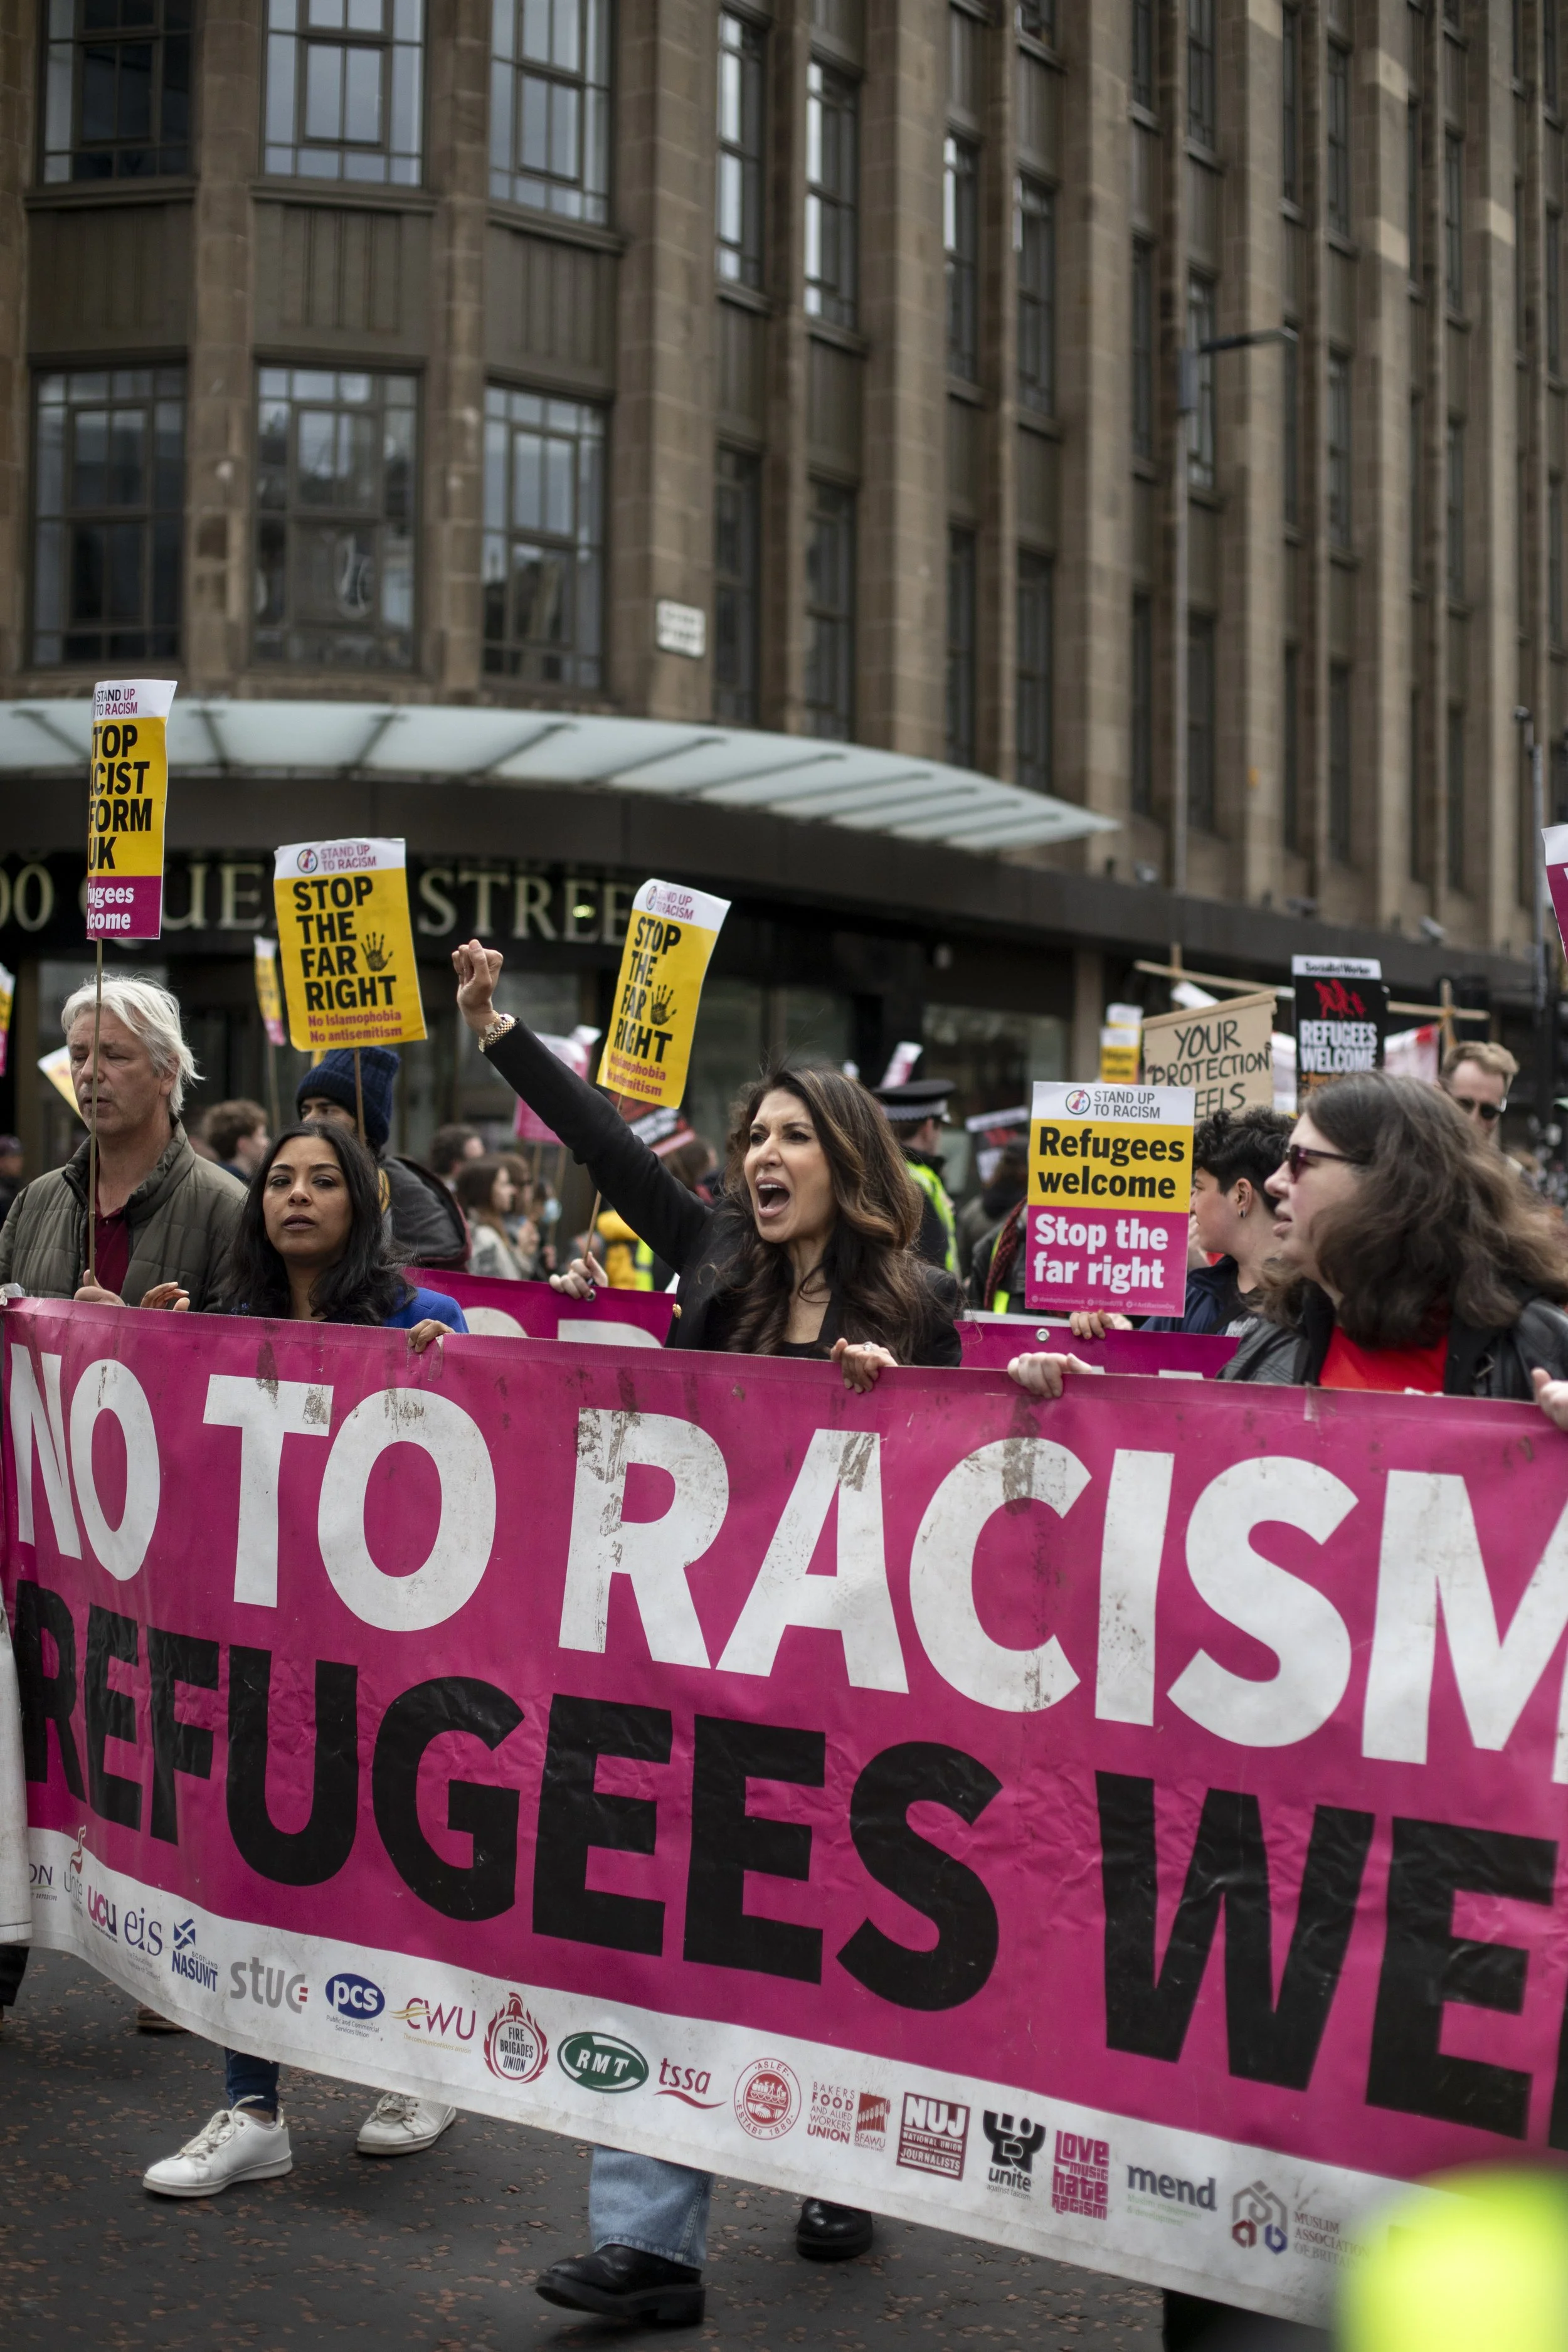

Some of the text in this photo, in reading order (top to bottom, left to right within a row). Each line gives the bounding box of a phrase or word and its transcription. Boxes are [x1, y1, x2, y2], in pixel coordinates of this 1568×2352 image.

[97, 689, 135, 702] STAND UP
[97, 702, 137, 716] TO RACISM
[92, 724, 138, 758] TOP
[90, 761, 150, 796] CIST
[89, 798, 152, 834] FORM
[88, 837, 117, 870] UK
[320, 845, 370, 859] STAND UP
[322, 857, 376, 871] TO RACISM
[0, 862, 54, 932] 0
[417, 868, 637, 946] STREE
[87, 883, 134, 908] fugees
[293, 876, 373, 911] STOP
[679, 894, 692, 906] UP
[87, 909, 130, 930] lcome
[296, 911, 357, 945] THE
[635, 916, 681, 955] STOP
[300, 946, 358, 978] FAR
[628, 951, 658, 987] THE
[305, 975, 397, 1012] RIGHT
[620, 984, 647, 1021] FAR
[308, 1009, 401, 1027] No Islamophobia
[309, 1026, 402, 1043] No antisemitism
[613, 1018, 673, 1063] RIGHT
[1174, 1020, 1242, 1061] YOUR
[1299, 1019, 1378, 1048] REFUGEES
[1300, 1046, 1377, 1073] WELCOME
[1094, 1091, 1155, 1104] STAND UP
[1194, 1082, 1246, 1118] EELS
[1094, 1104, 1160, 1118] TO RACISM
[1039, 1126, 1185, 1167] Refugees
[1037, 1166, 1176, 1199] welcome
[1035, 1214, 1168, 1254] Stop the
[1034, 1252, 1164, 1295] far right
[11, 1343, 1568, 1784] NO TO RACISM
[15, 1579, 1568, 2151] REFUGEES WE
[124, 1907, 163, 1956] eis
[171, 1950, 218, 1993] NASUWT
[191, 1951, 218, 1969] SCOTLAND
[332, 1980, 378, 2011] pcs
[326, 2015, 379, 2033] Public and Commercial
[406, 1997, 477, 2040] CWU
[335, 2025, 369, 2038] Services Union
[411, 2035, 455, 2051] communications
[508, 2026, 524, 2042] FIRE
[500, 2039, 534, 2059] BRIGADES
[503, 2055, 526, 2072] UNION
[576, 2048, 629, 2078] RMT
[757, 2061, 788, 2075] ASLEF
[658, 2057, 711, 2095] tssa
[812, 2092, 854, 2112] FOOD
[813, 2082, 856, 2100] BAKERS
[810, 2114, 851, 2131] WORKERS
[811, 2104, 852, 2121] AND ALLIED
[904, 2095, 967, 2137] NUJ
[769, 2117, 792, 2136] 1880
[807, 2124, 850, 2144] UNION
[854, 2132, 886, 2148] BFAWU
[903, 2132, 962, 2153] NATIONAL UNION
[900, 2148, 961, 2170] JOURNALISTS
[986, 2183, 1032, 2201] against fascism
[988, 2167, 1032, 2192] unite
[1126, 2164, 1217, 2212] mend
[1293, 2210, 1340, 2234] MUSLIM
[1293, 2242, 1310, 2257] OF
